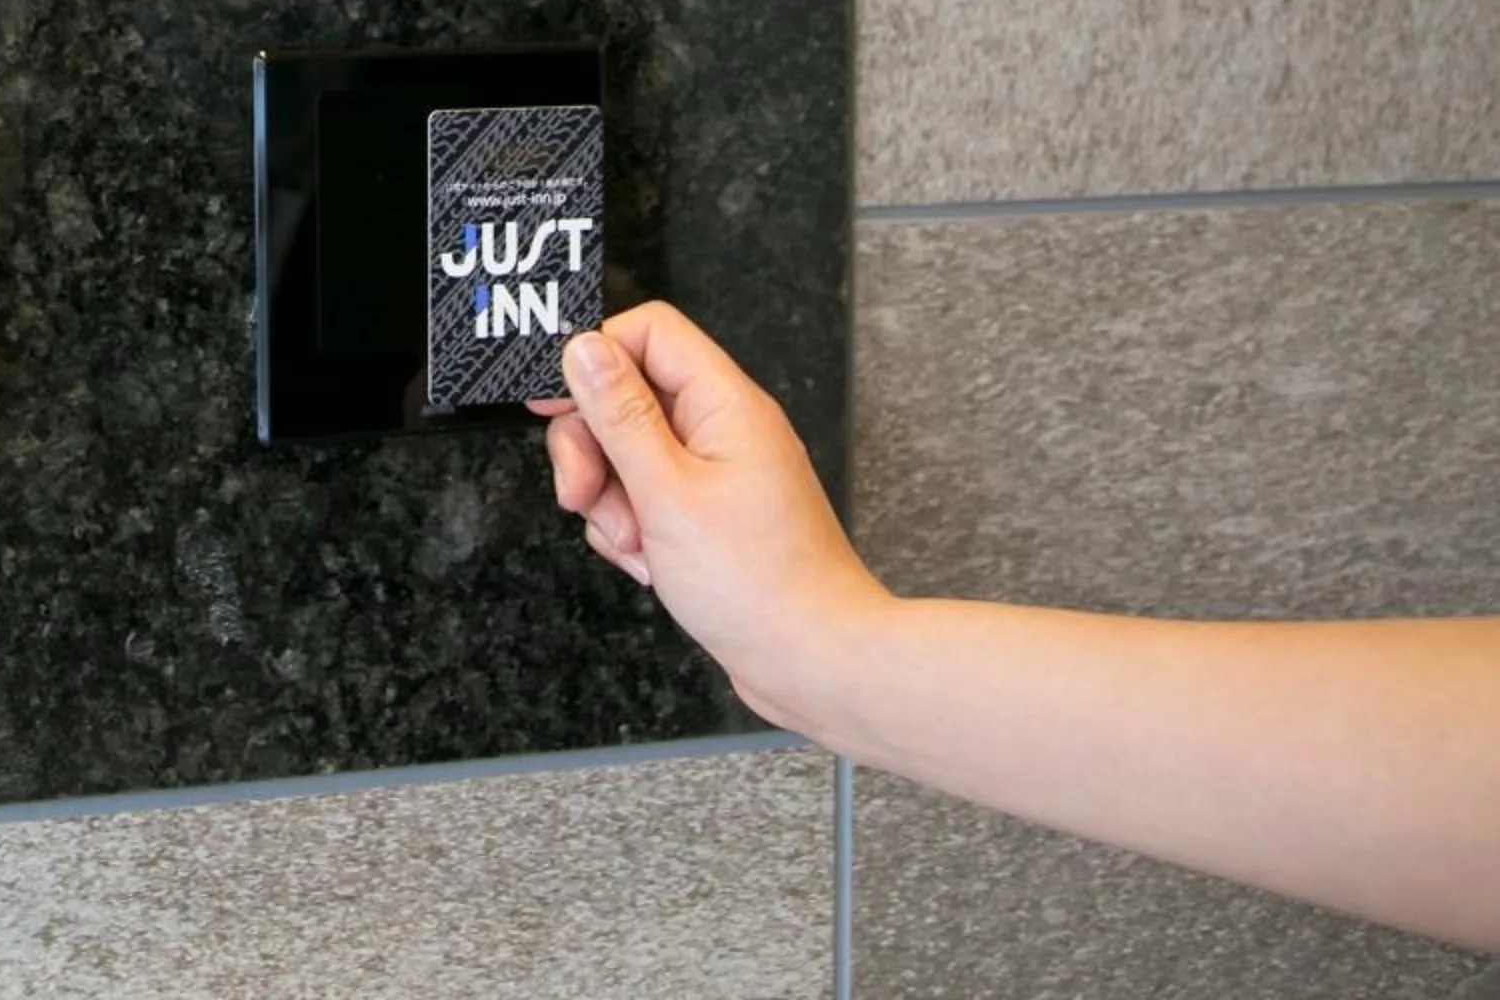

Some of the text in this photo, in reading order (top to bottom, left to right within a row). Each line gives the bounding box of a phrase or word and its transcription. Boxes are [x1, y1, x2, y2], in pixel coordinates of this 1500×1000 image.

[467, 191, 567, 209] www.just-inn.jp
[440, 218, 593, 278] JUST
[474, 281, 559, 339] INN
